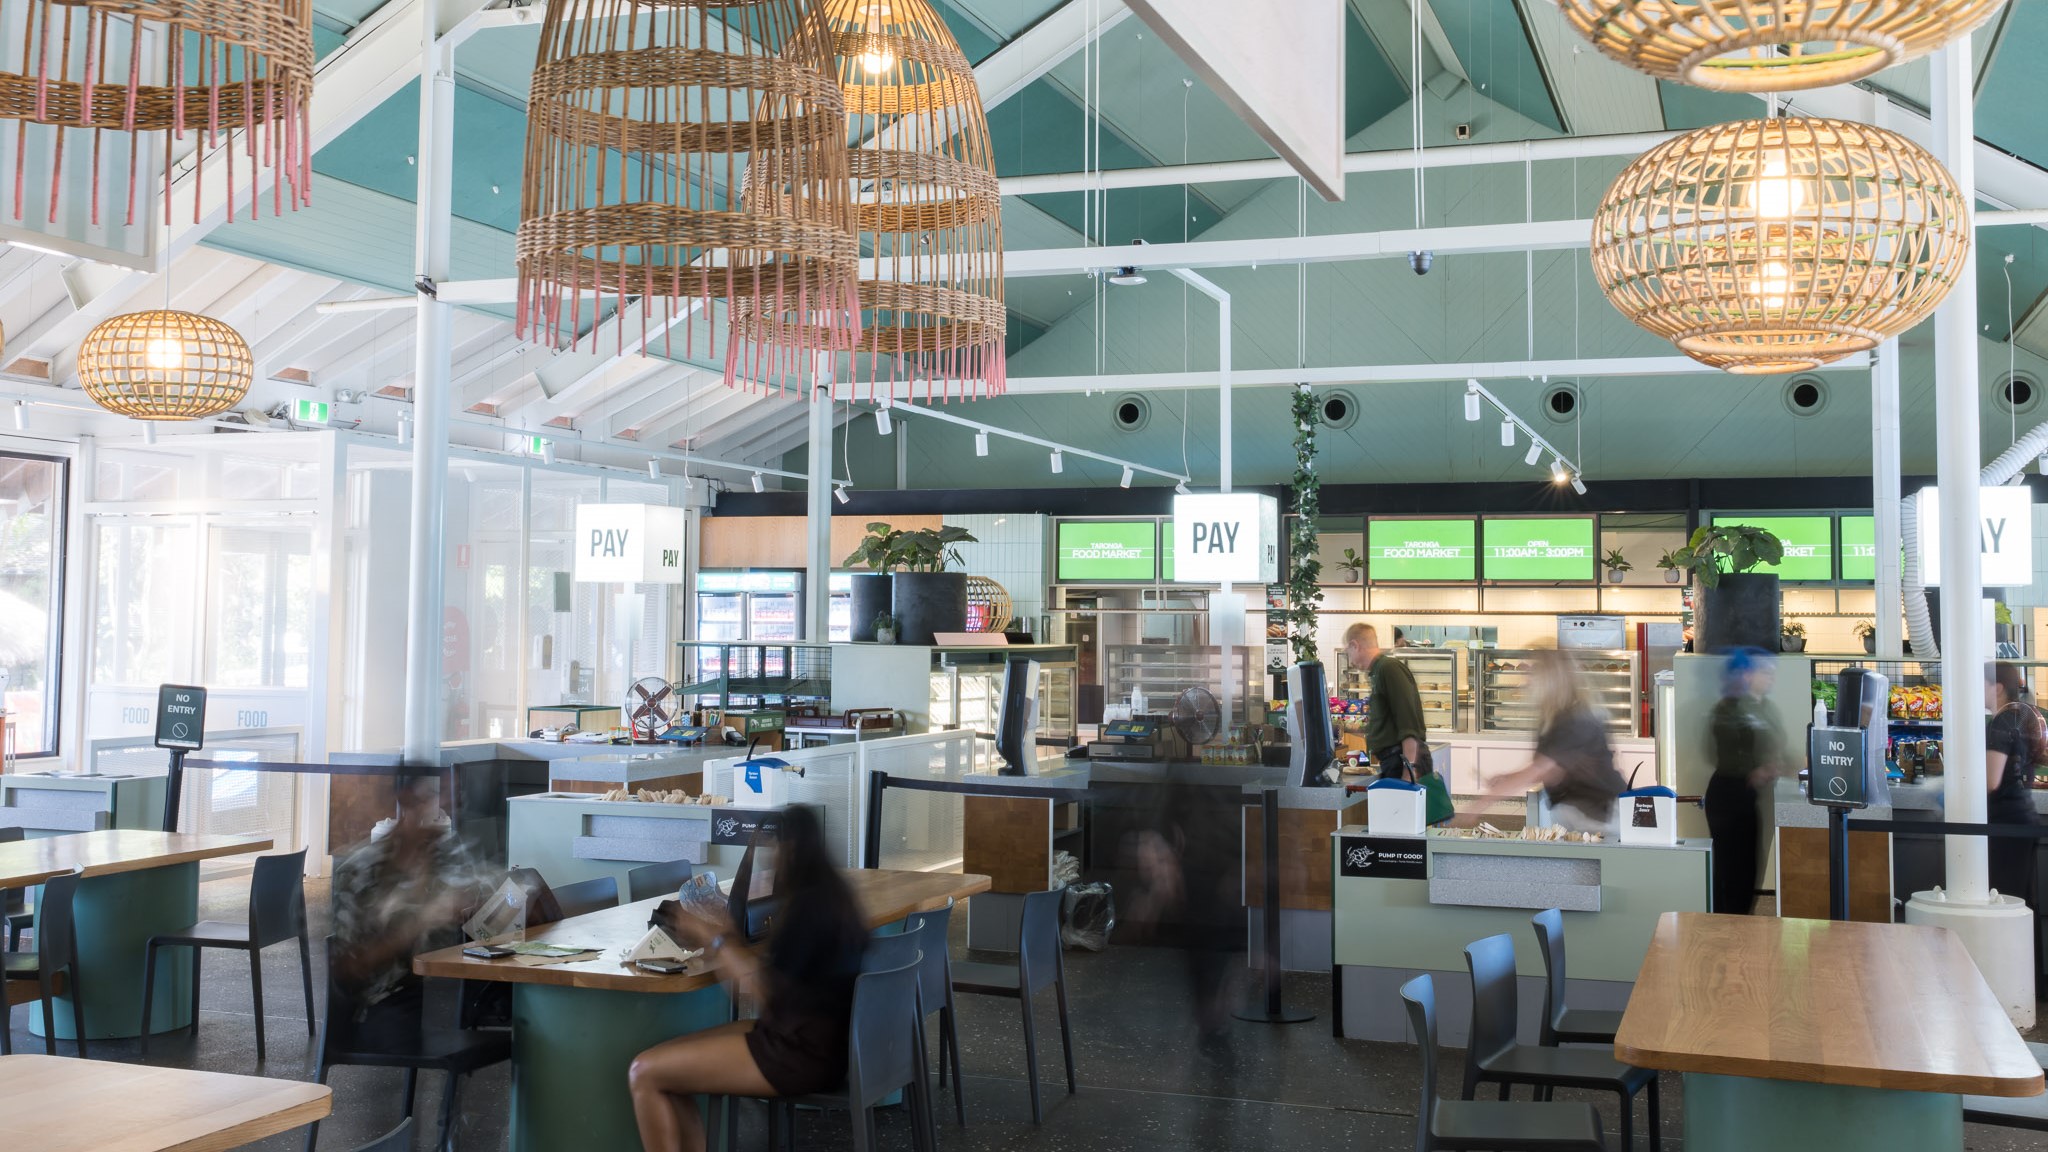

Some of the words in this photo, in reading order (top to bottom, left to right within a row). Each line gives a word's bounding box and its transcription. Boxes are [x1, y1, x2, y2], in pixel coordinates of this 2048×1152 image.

[590, 528, 629, 557] PAY
[1192, 521, 1240, 554] PAY
[1527, 540, 1549, 548] OPEN
[1072, 549, 1100, 559] FOOD
[1102, 549, 1142, 559] MARKET
[1383, 548, 1413, 558] FOOD
[1415, 548, 1461, 558] MARKET
[1494, 547, 1538, 558] 11:00AM
[1546, 547, 1584, 558] 3:00PM
[1783, 546, 1816, 557] RKET
[662, 549, 680, 568] PAY
[175, 693, 190, 704] NO
[167, 704, 196, 716] ENTRY
[122, 707, 150, 725] FOOD
[237, 710, 268, 728] FOOD
[1828, 741, 1845, 752] NO
[1820, 755, 1854, 767] ENTRY
